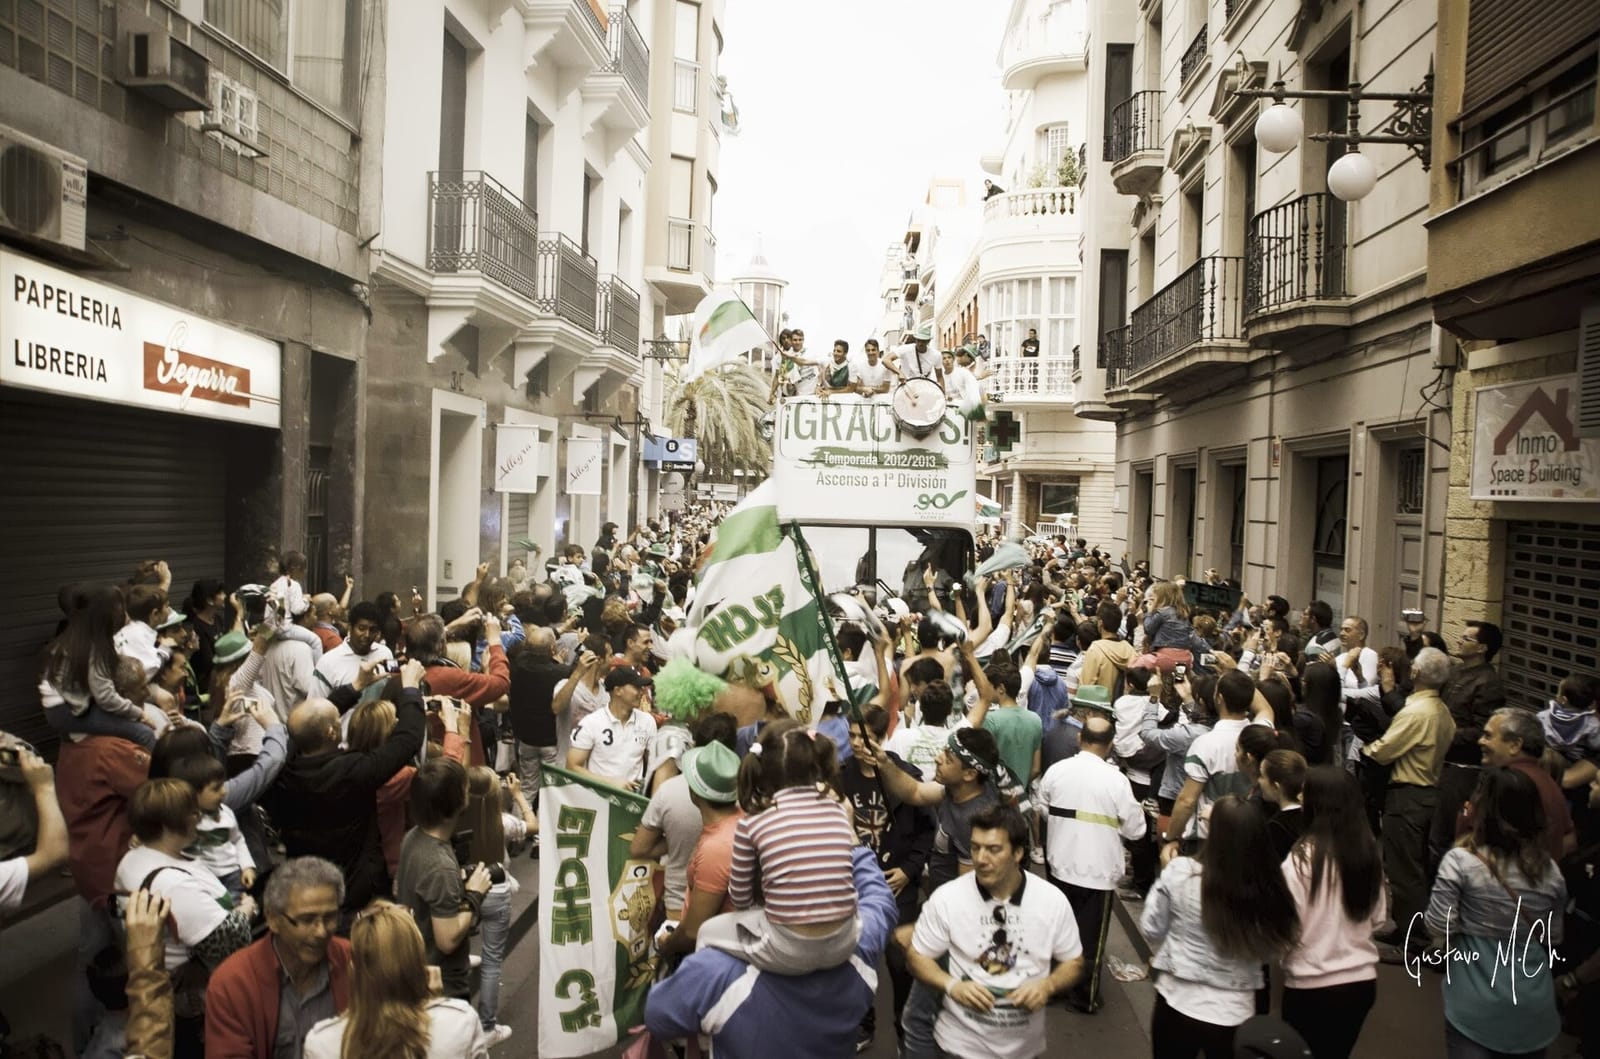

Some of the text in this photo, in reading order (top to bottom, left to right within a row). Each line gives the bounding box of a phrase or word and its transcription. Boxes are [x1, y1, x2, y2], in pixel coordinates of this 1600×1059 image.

[14, 273, 122, 331] PAPELERIA
[14, 338, 107, 383] LIBRERIA
[784, 401, 971, 446] ¡GRACIS!
[1516, 432, 1557, 455] Inmo
[823, 451, 936, 468] Temporada 2012/2013
[1490, 458, 1582, 486] Space Building
[816, 471, 947, 489] Ascenso a 1ª División
[602, 728, 614, 746] 3
